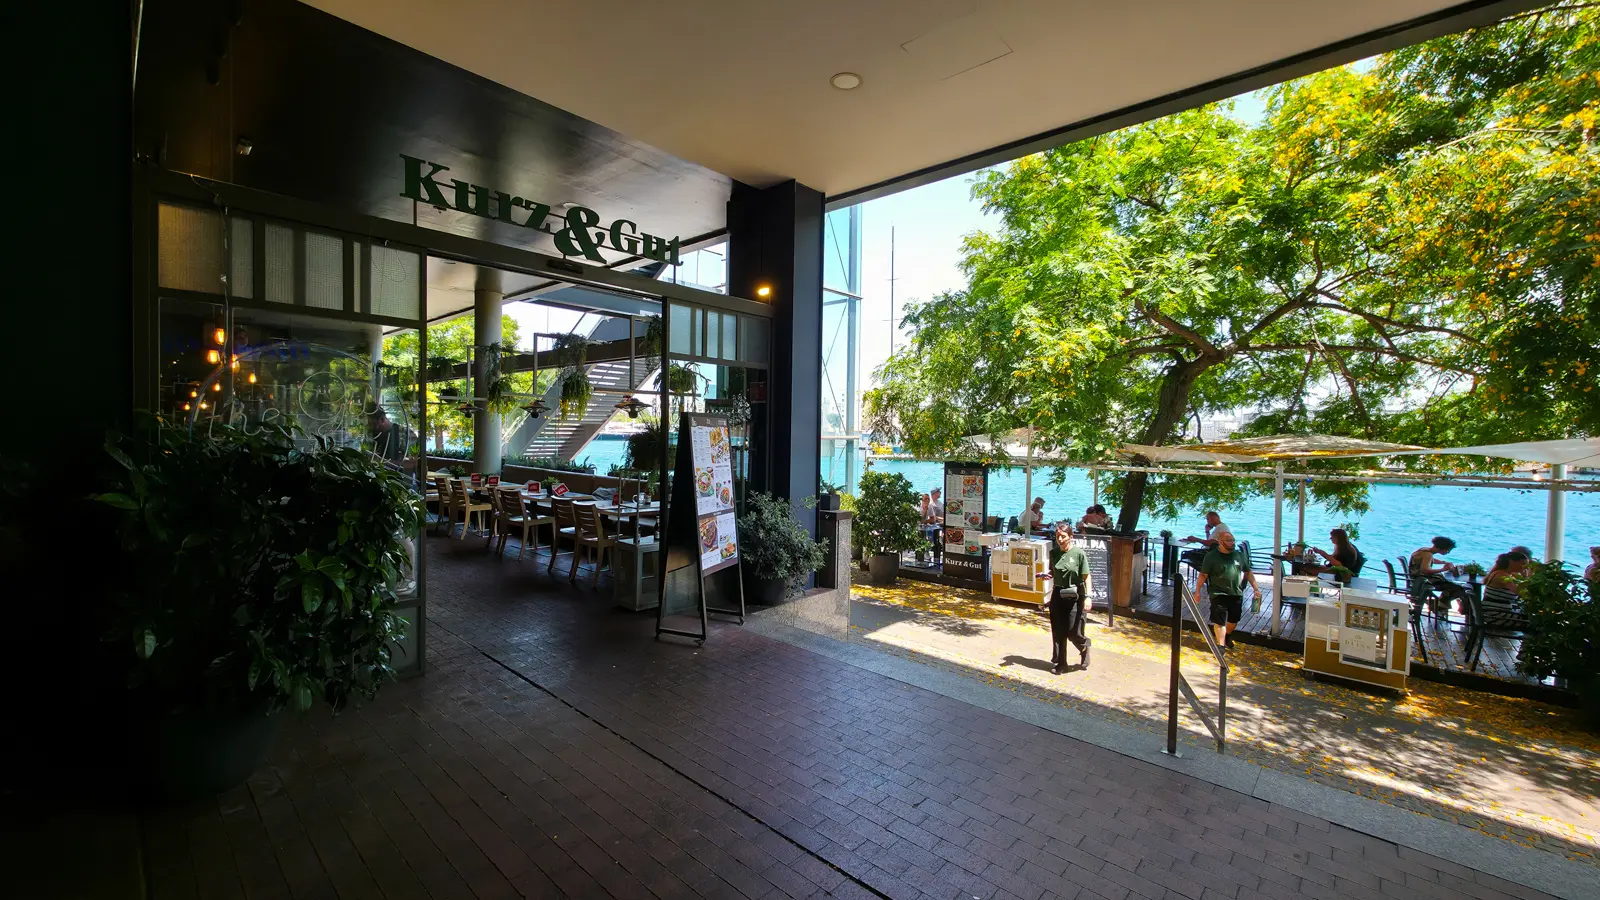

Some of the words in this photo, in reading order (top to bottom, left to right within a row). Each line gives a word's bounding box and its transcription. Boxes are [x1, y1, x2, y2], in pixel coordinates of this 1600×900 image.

[399, 153, 551, 233] Kurz
[554, 206, 607, 264] &
[610, 219, 684, 267] Gut
[945, 557, 962, 566] Kurz
[969, 561, 983, 570] Gut
